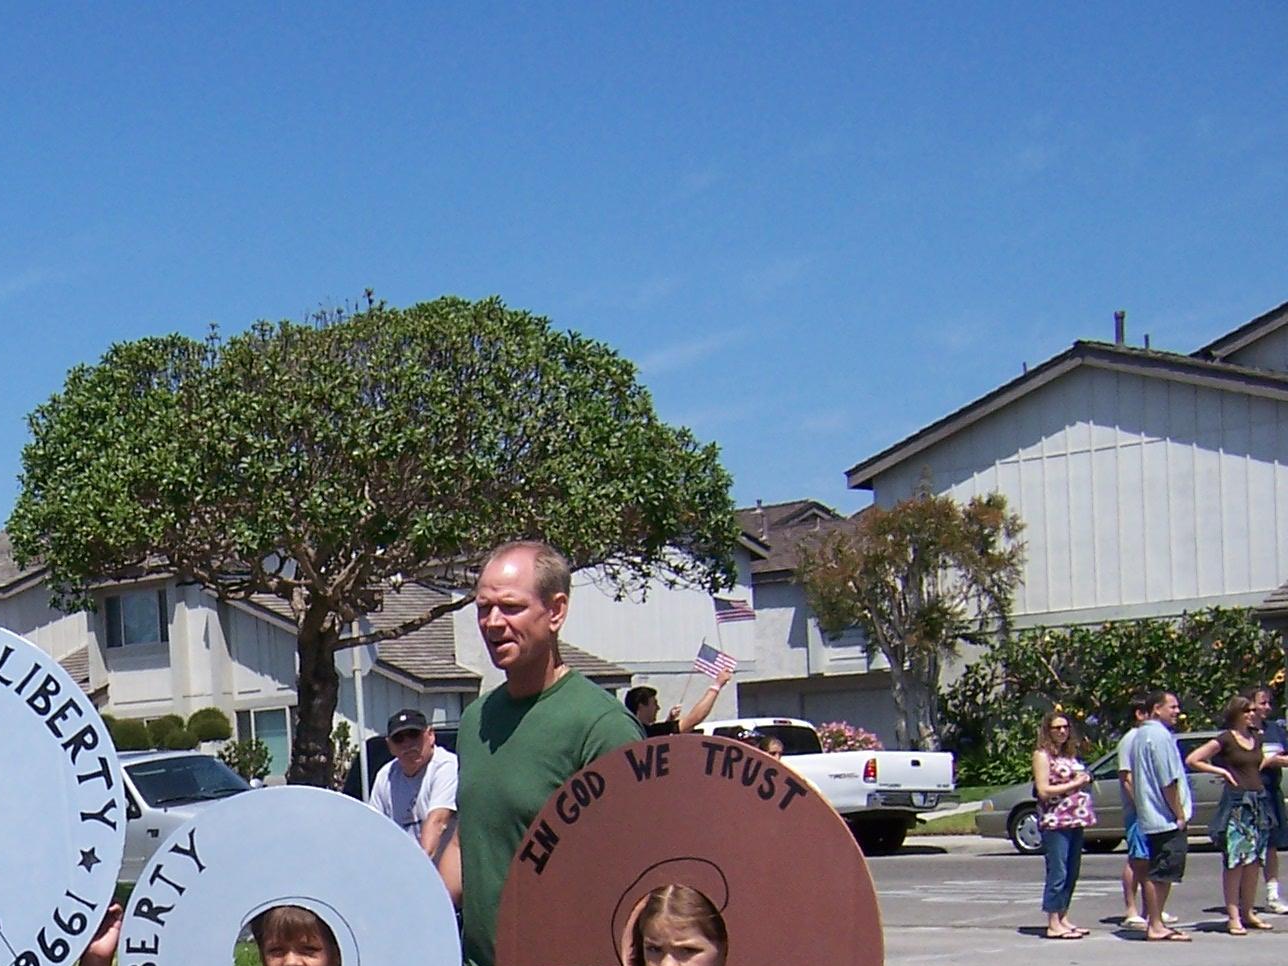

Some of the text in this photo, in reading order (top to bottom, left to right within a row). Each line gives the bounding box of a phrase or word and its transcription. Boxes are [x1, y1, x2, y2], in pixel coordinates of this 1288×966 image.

[520, 741, 808, 876] IN GOD WE TRUST
